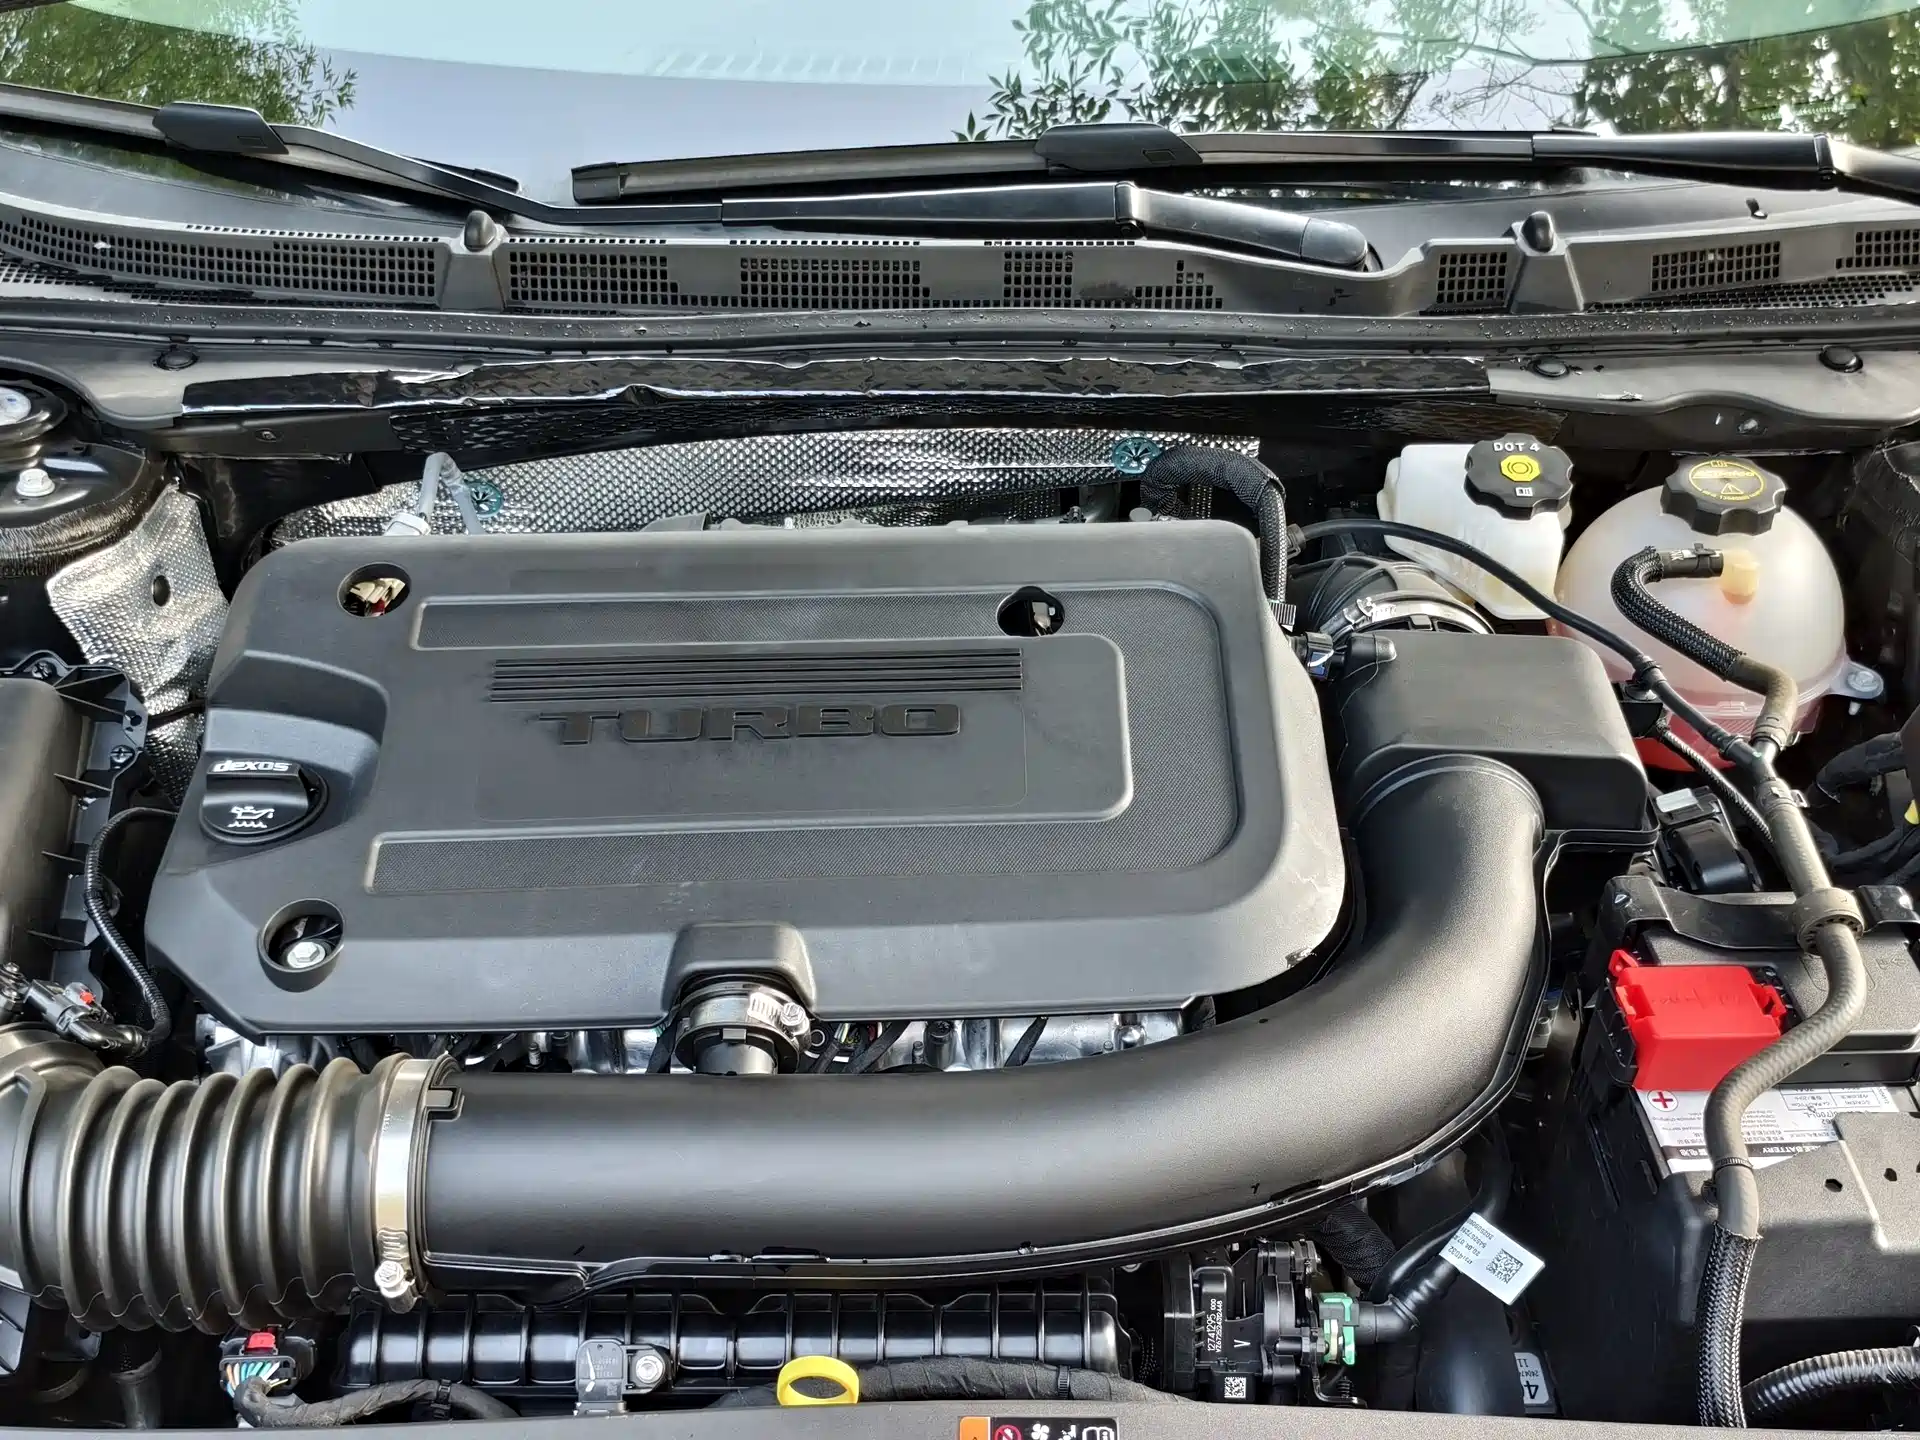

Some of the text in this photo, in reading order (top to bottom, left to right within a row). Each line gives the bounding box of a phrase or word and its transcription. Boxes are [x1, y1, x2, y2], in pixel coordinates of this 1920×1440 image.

[1493, 442, 1540, 452] DOT 4
[538, 703, 962, 745] TURBO
[212, 759, 292, 773] dexos
[1761, 1144, 1802, 1154] BATTERY
[1206, 1313, 1216, 1351] 12741295
[1524, 1380, 1539, 1400] 4
